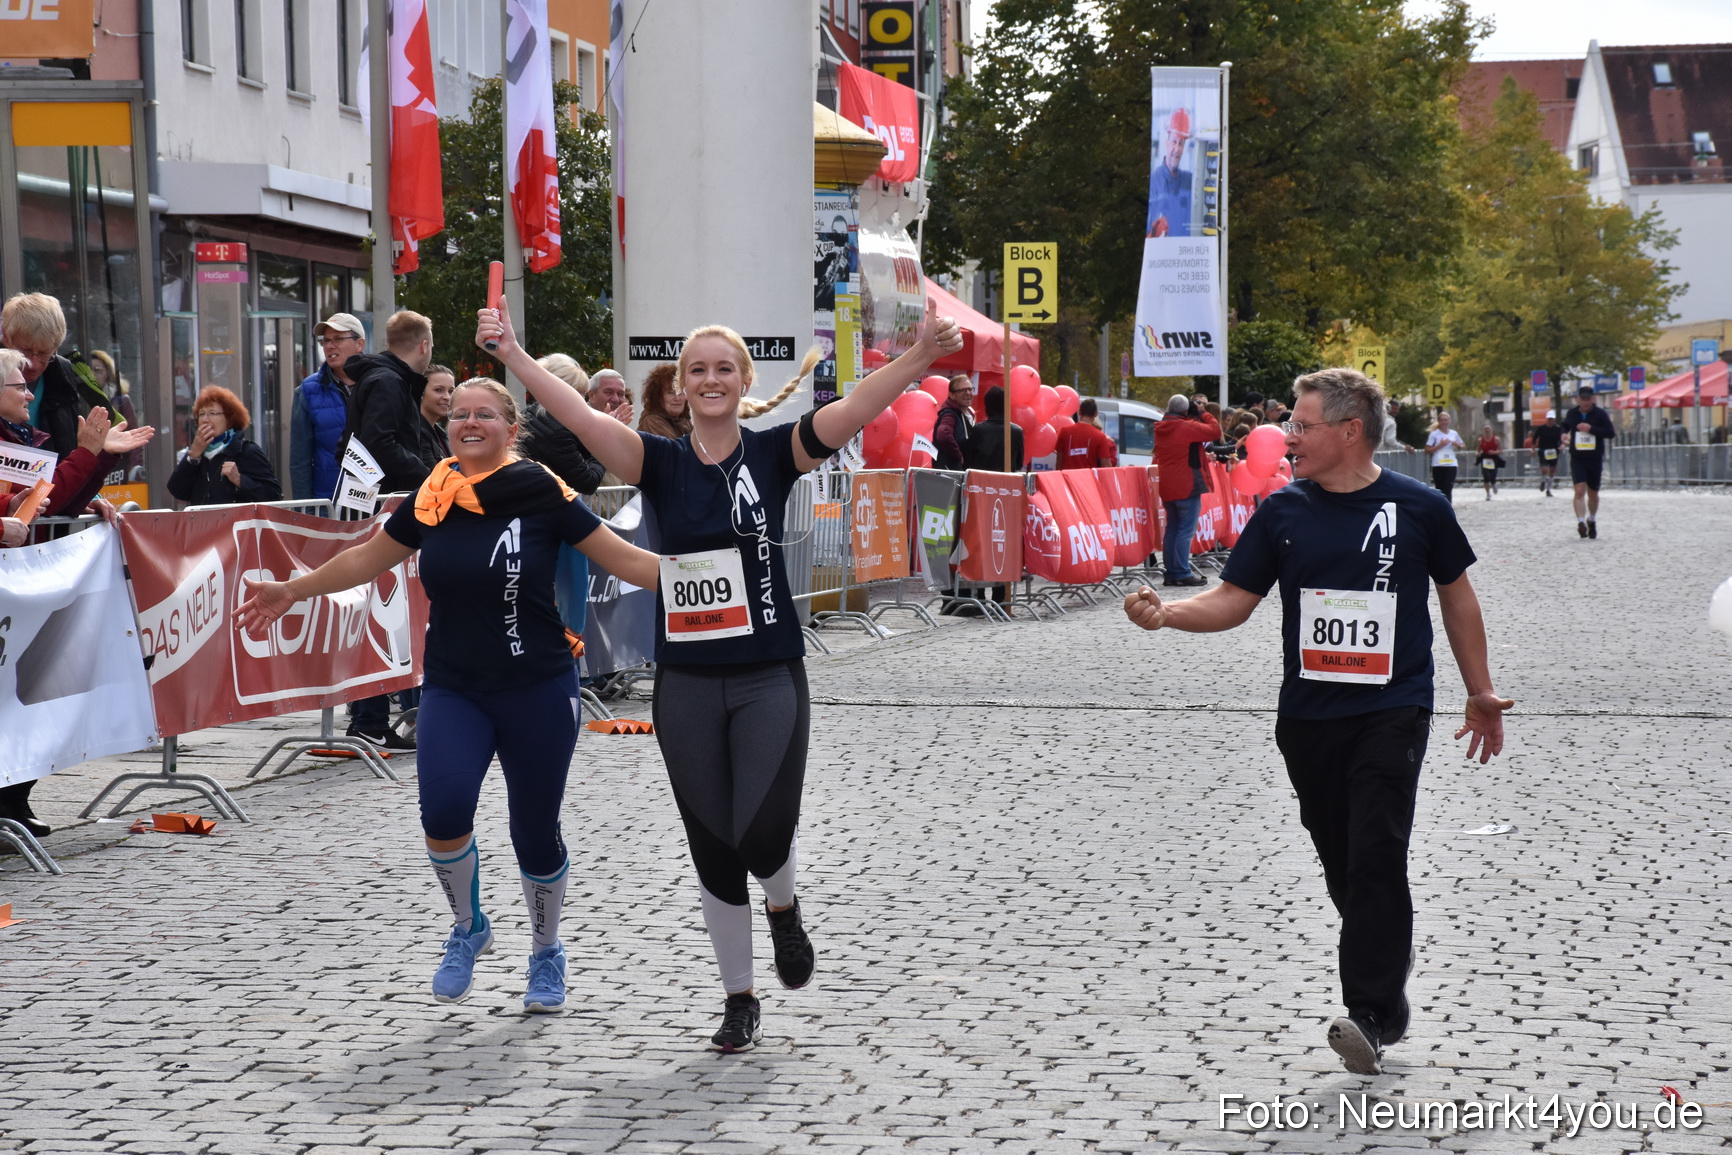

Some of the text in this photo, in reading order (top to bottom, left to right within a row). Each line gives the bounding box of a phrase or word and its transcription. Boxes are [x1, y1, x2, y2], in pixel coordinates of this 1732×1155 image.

[1010, 246, 1051, 260] Block
[205, 272, 230, 280] HotSpot
[1018, 267, 1044, 305] B
[1358, 348, 1381, 357] Block
[1433, 384, 1444, 399] D
[345, 448, 367, 468] swn
[348, 488, 367, 500] swn
[752, 507, 777, 624] RAIL.ONE
[674, 577, 732, 607] 8009
[504, 559, 524, 656] RAIL.ONE
[142, 608, 180, 668] DAS
[186, 570, 218, 643] NEUE
[685, 613, 724, 626] RAIL.ONE
[1313, 617, 1380, 648] 8013
[1322, 655, 1367, 667] RAIL.ONE
